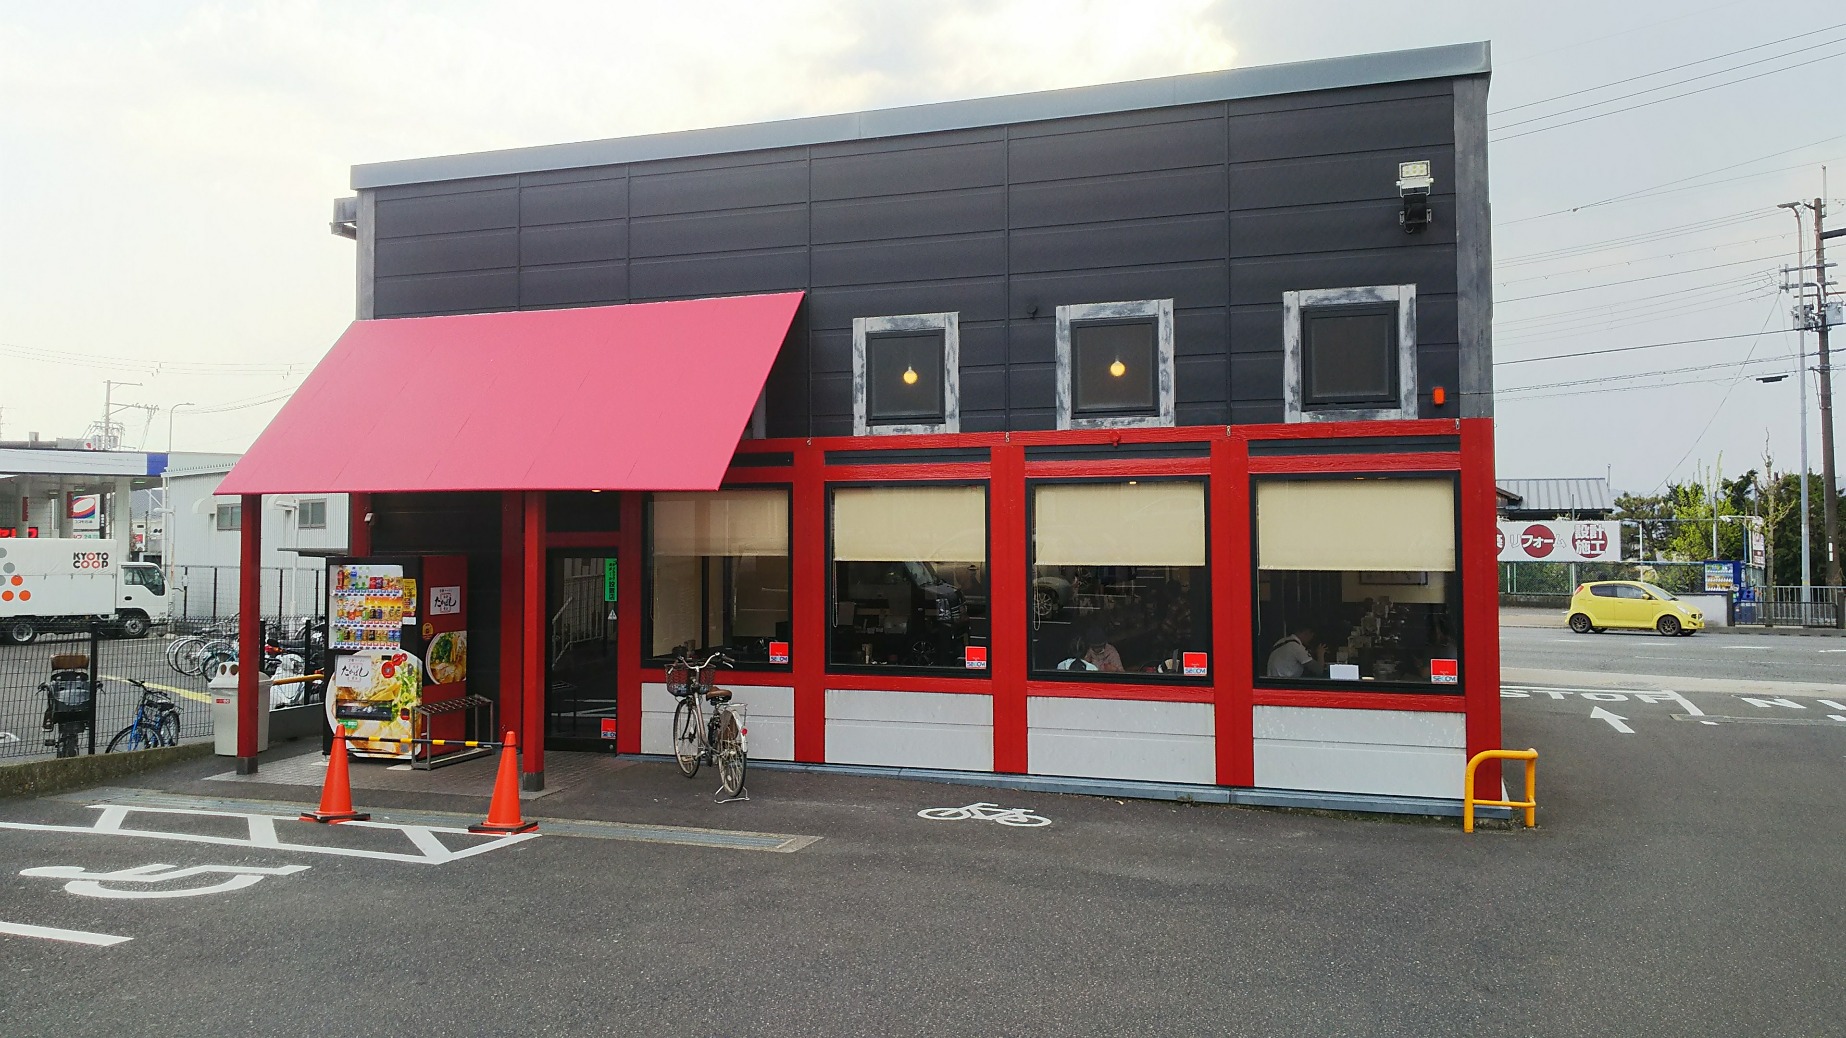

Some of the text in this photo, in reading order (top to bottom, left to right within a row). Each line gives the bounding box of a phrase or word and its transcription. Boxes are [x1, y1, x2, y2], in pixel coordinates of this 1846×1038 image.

[1574, 524, 1605, 540] 設計
[1510, 533, 1567, 549] リフォーム
[1574, 539, 1606, 555] 施工
[73, 552, 109, 561] KYOTO
[73, 560, 109, 569] COOP
